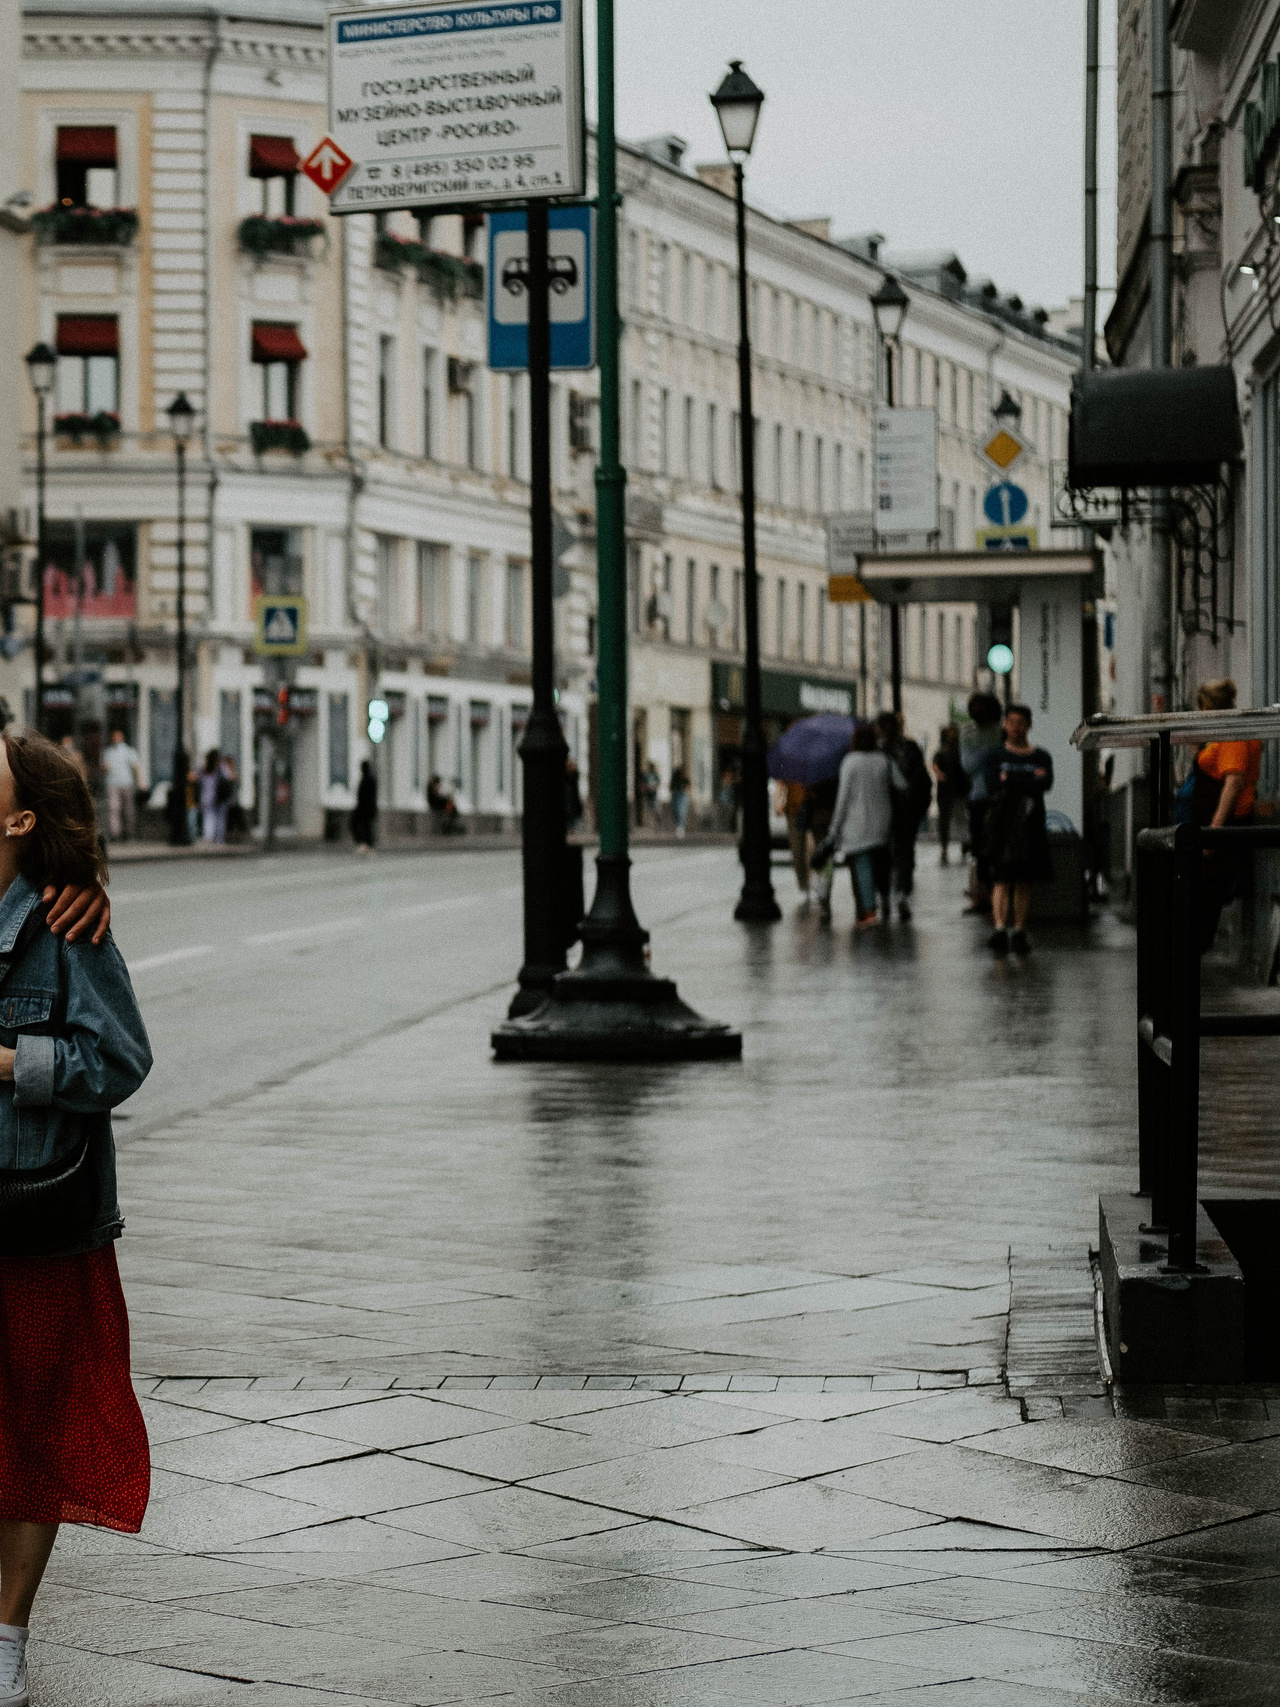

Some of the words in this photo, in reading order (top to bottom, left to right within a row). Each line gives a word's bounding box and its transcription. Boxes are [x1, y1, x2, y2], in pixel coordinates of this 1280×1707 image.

[342, 15, 454, 39] МИНИСТЕРСТВО
[455, 7, 530, 28] КУЛЬТУРЫ
[532, 4, 557, 20] РФ
[361, 63, 536, 97] ГОСУДАРСТВЕННЫЙ
[376, 126, 432, 147] ЦЕНТР
